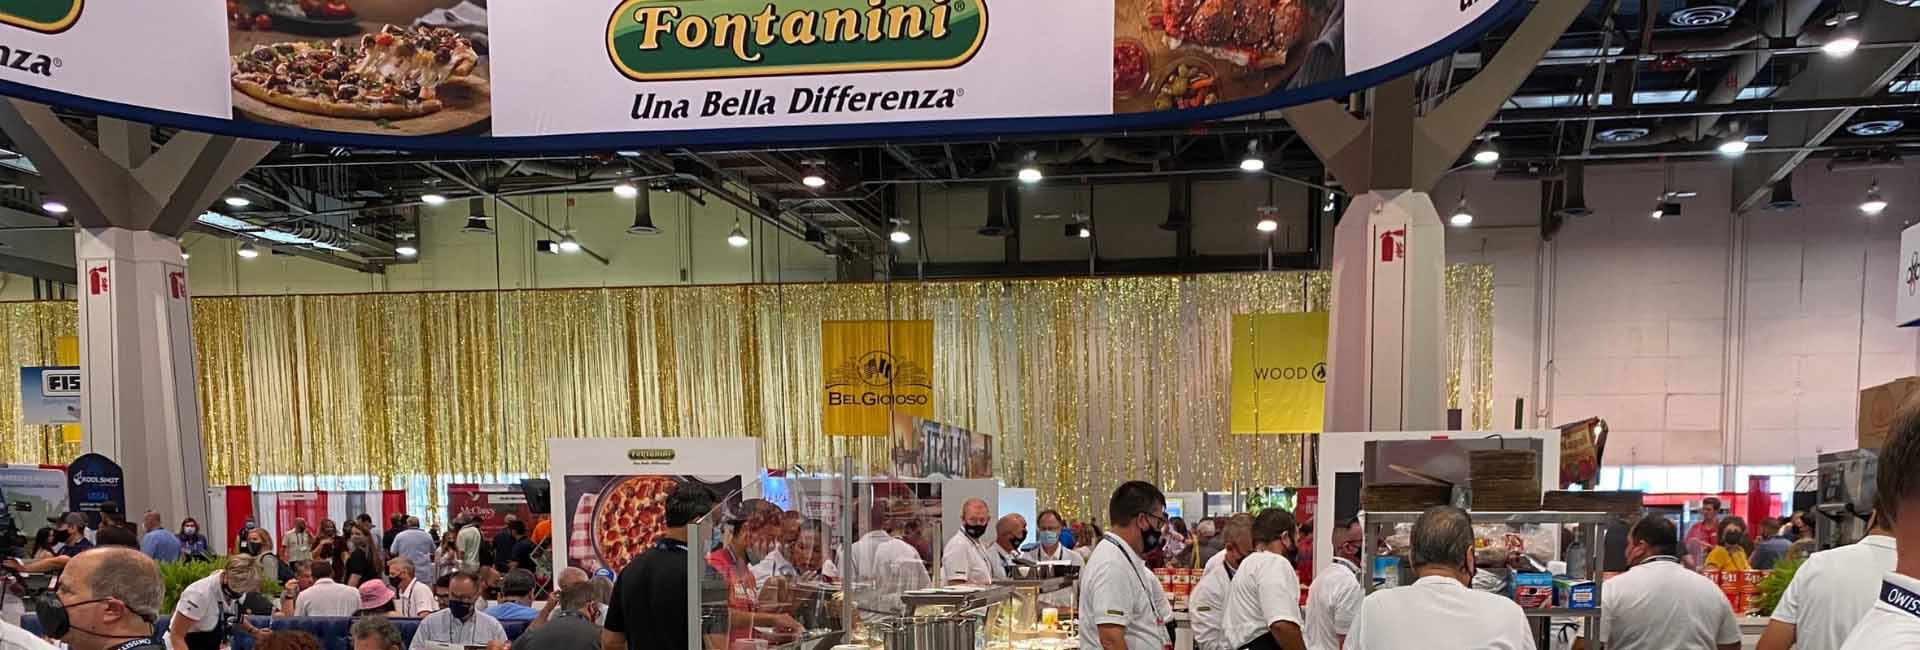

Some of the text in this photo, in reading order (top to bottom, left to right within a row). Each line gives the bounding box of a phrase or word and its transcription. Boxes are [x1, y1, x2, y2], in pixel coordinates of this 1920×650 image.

[633, 0, 952, 62] Fontanini
[630, 85, 955, 119] Una Bella Differenza
[1254, 367, 1308, 380] WOOD
